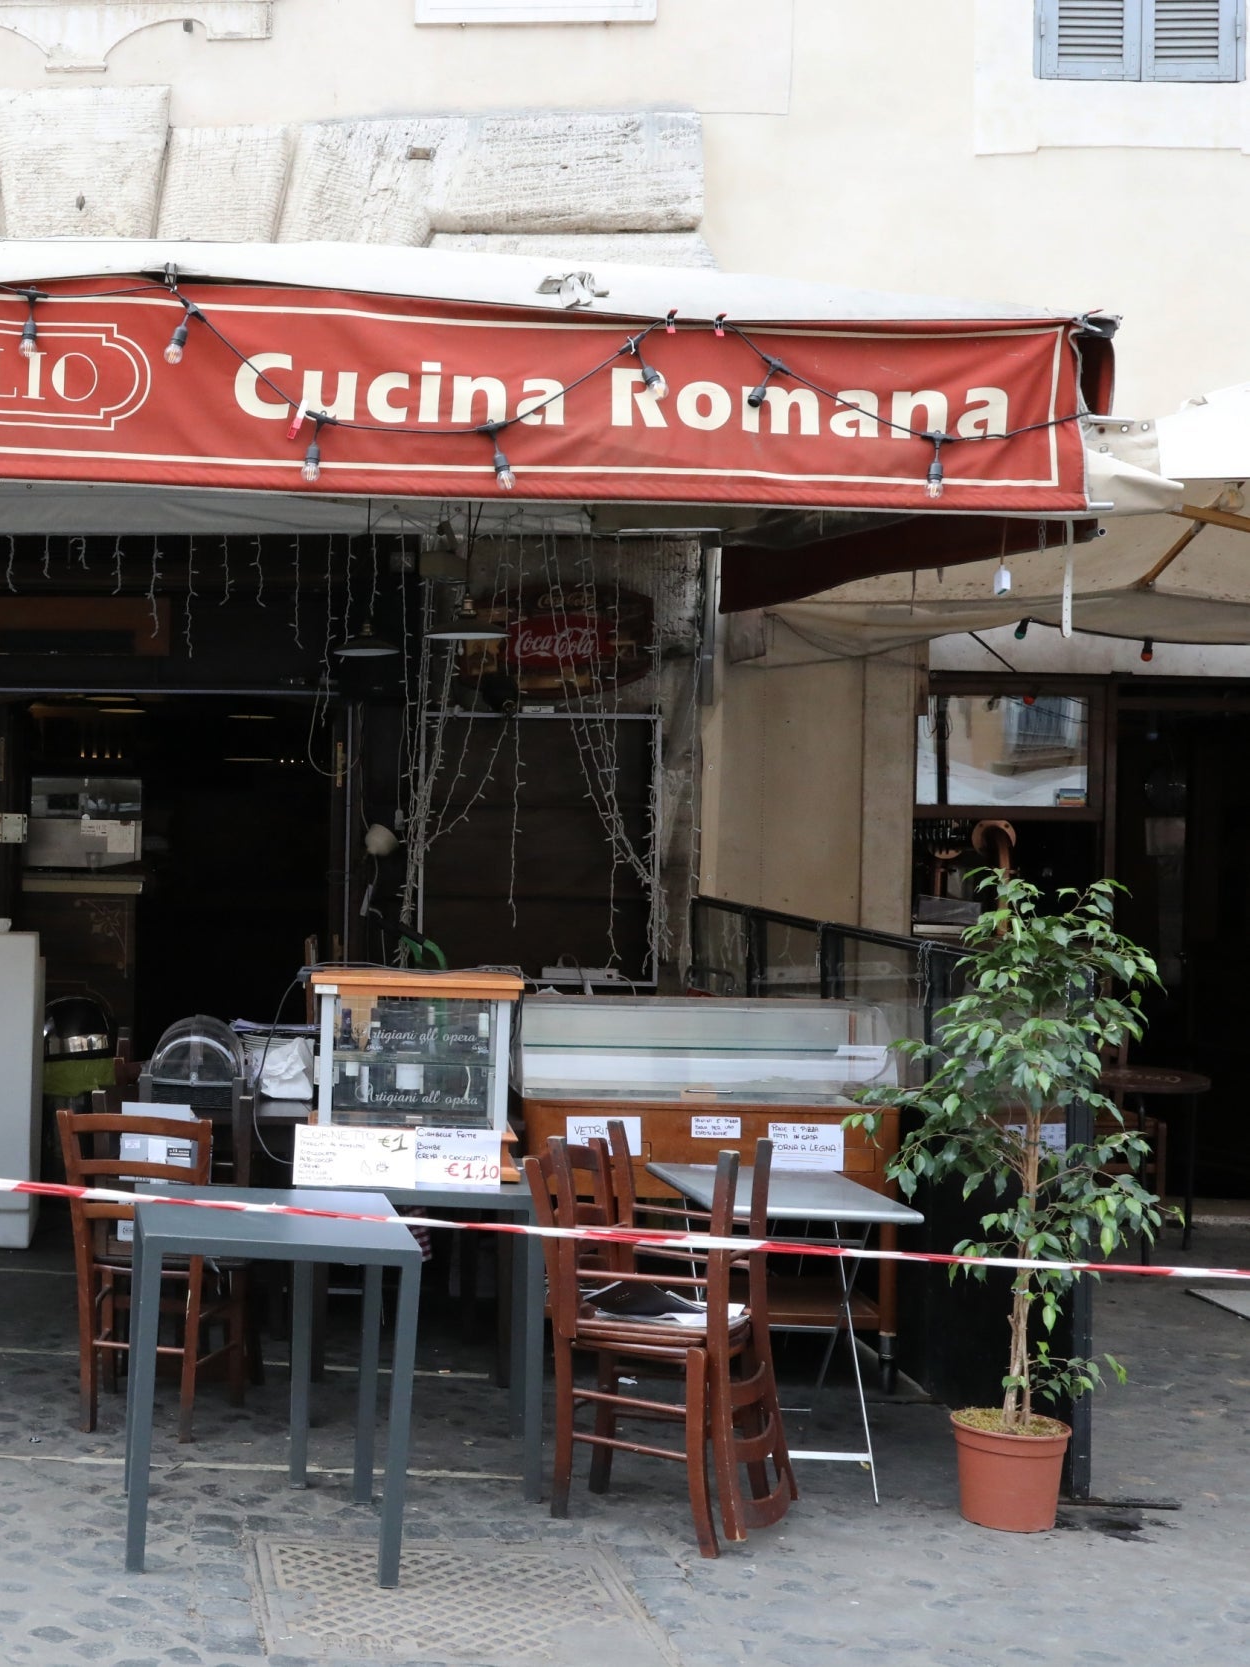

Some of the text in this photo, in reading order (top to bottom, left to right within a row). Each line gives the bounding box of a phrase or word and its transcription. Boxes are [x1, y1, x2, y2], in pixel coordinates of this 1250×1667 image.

[234, 352, 1010, 440] Cucina Romana
[351, 1022, 418, 1044] Artigiani
[442, 1032, 478, 1045] opera
[355, 1083, 419, 1107] Artigiani
[445, 1096, 478, 1109] opera
[300, 1128, 375, 1141] CORNETTO
